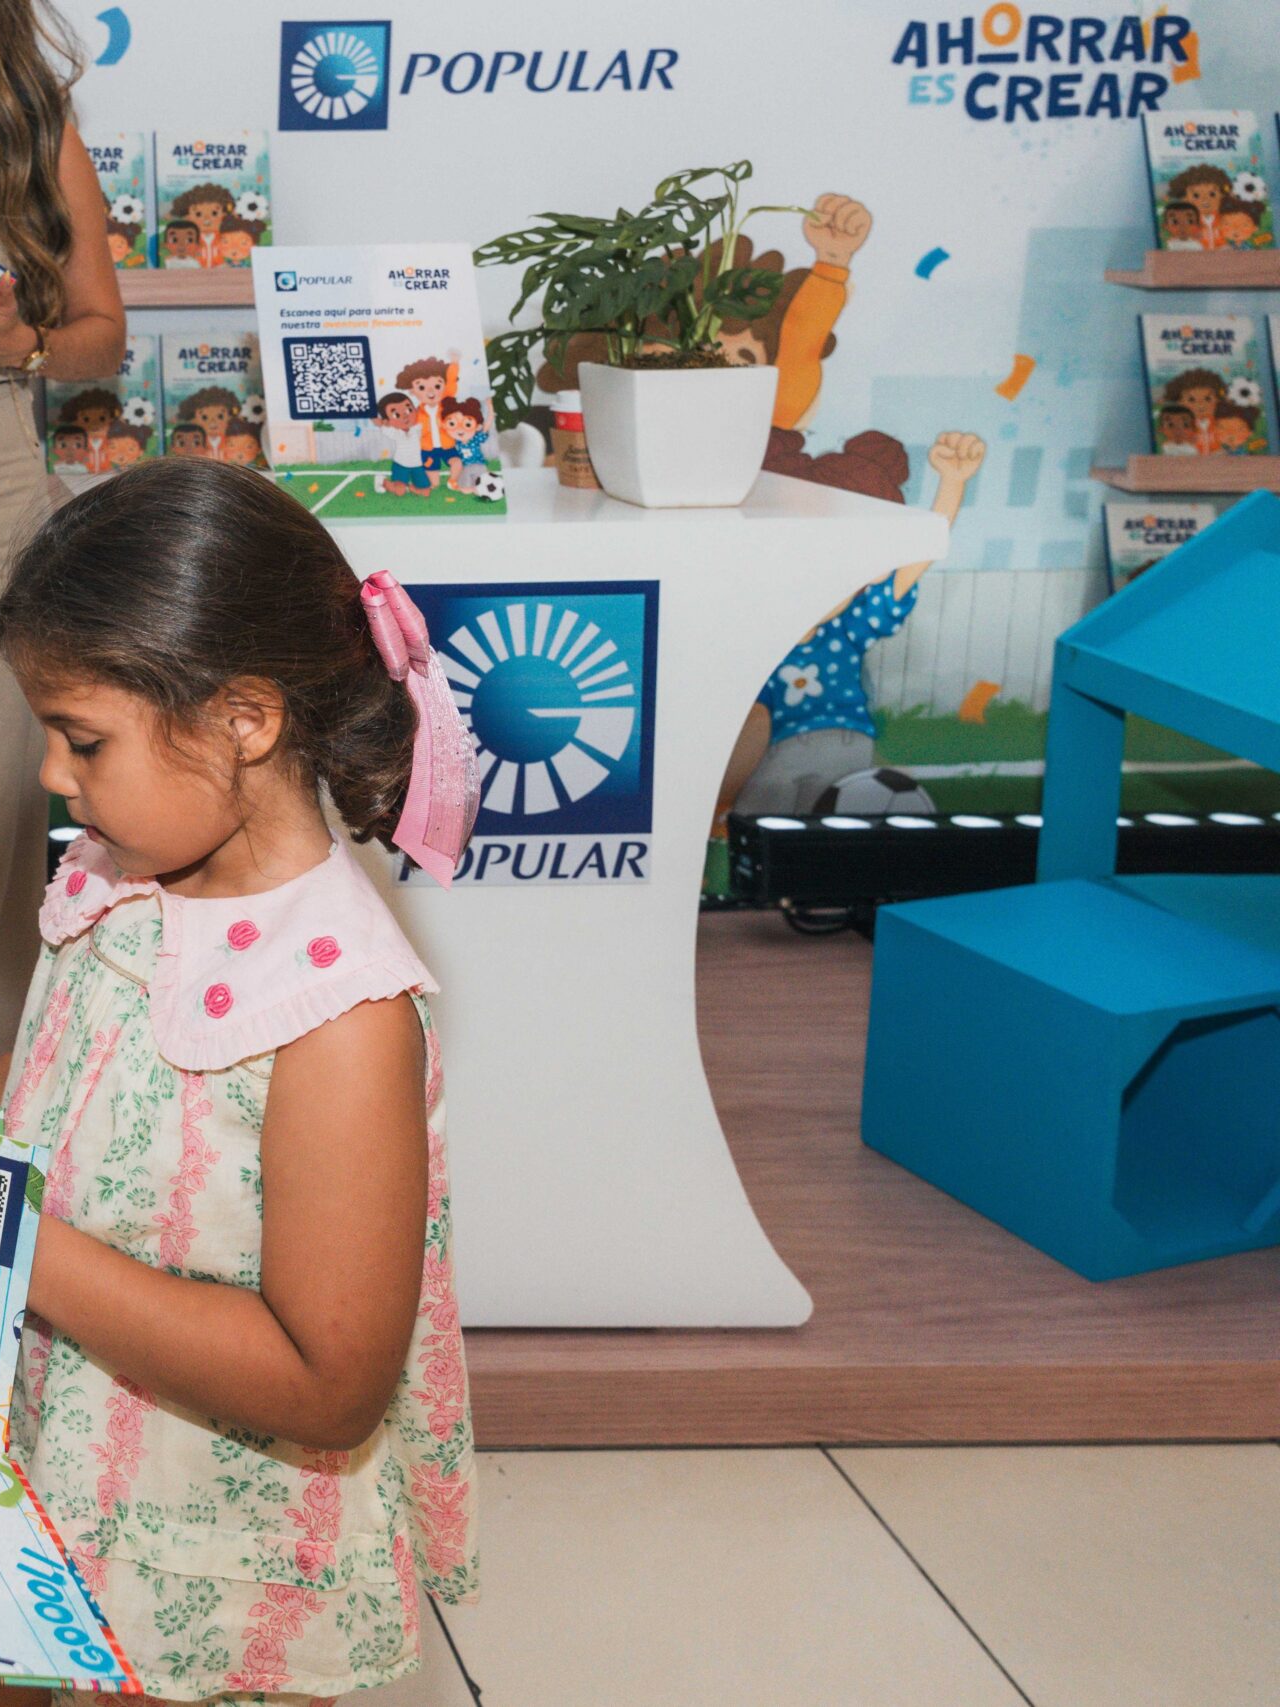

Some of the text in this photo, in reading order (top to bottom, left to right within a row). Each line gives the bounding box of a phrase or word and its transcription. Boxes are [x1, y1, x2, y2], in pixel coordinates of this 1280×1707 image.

[891, 2, 1191, 68] AHORRAR
[399, 48, 679, 95] POPULAR
[908, 72, 1169, 123] ES CREAR
[173, 140, 247, 156] AHORRAR
[1185, 139, 1237, 151] CREAR
[192, 158, 243, 169] CREAR
[388, 266, 451, 280] AHORRAR
[298, 275, 353, 286] POPULAR
[405, 280, 448, 290] CREAR
[280, 306, 415, 318] Escanea aquí para unirte a
[281, 319, 321, 330] nuestra
[178, 343, 252, 360] AHORRAR
[197, 360, 249, 374] CREAR
